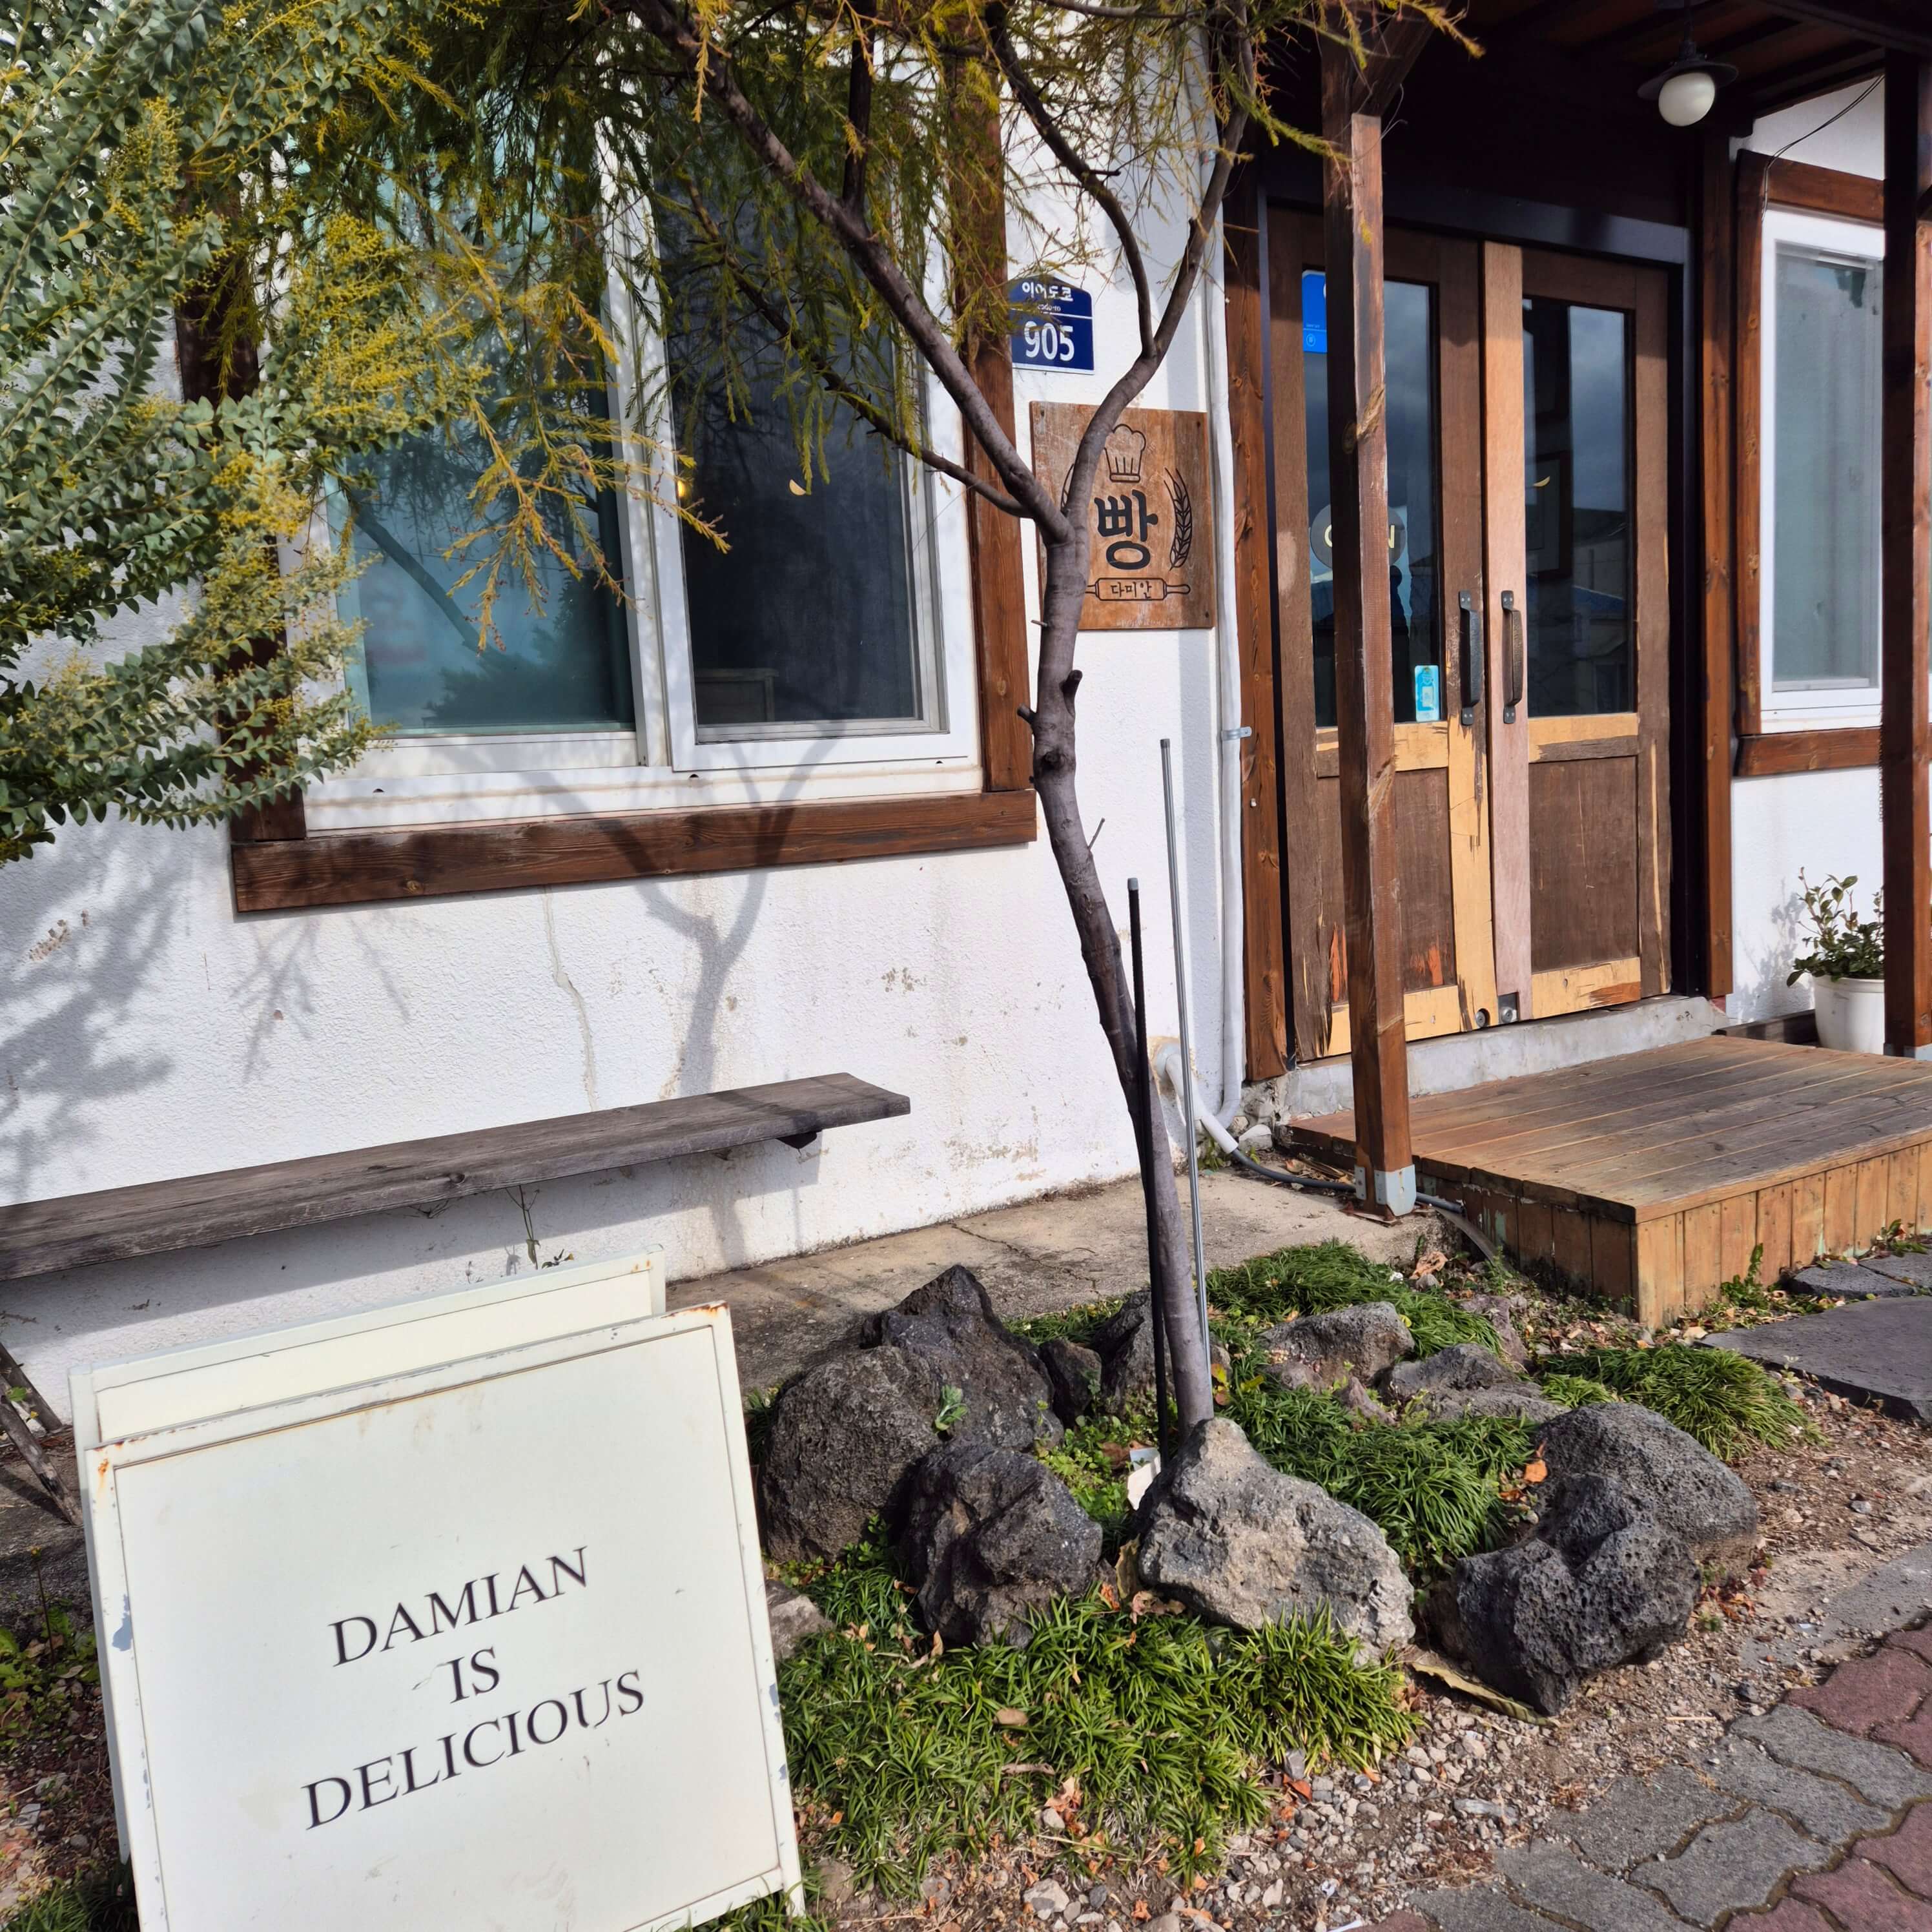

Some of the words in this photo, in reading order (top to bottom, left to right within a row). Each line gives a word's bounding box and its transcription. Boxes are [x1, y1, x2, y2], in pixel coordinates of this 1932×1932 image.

[1024, 321, 1074, 361] 905
[1094, 489, 1158, 570] 빵
[1111, 581, 1152, 599] 다미안
[328, 1546, 588, 1667] DAMIAN
[446, 1646, 501, 1704] IS
[301, 1670, 644, 1831] DELICIOUS
